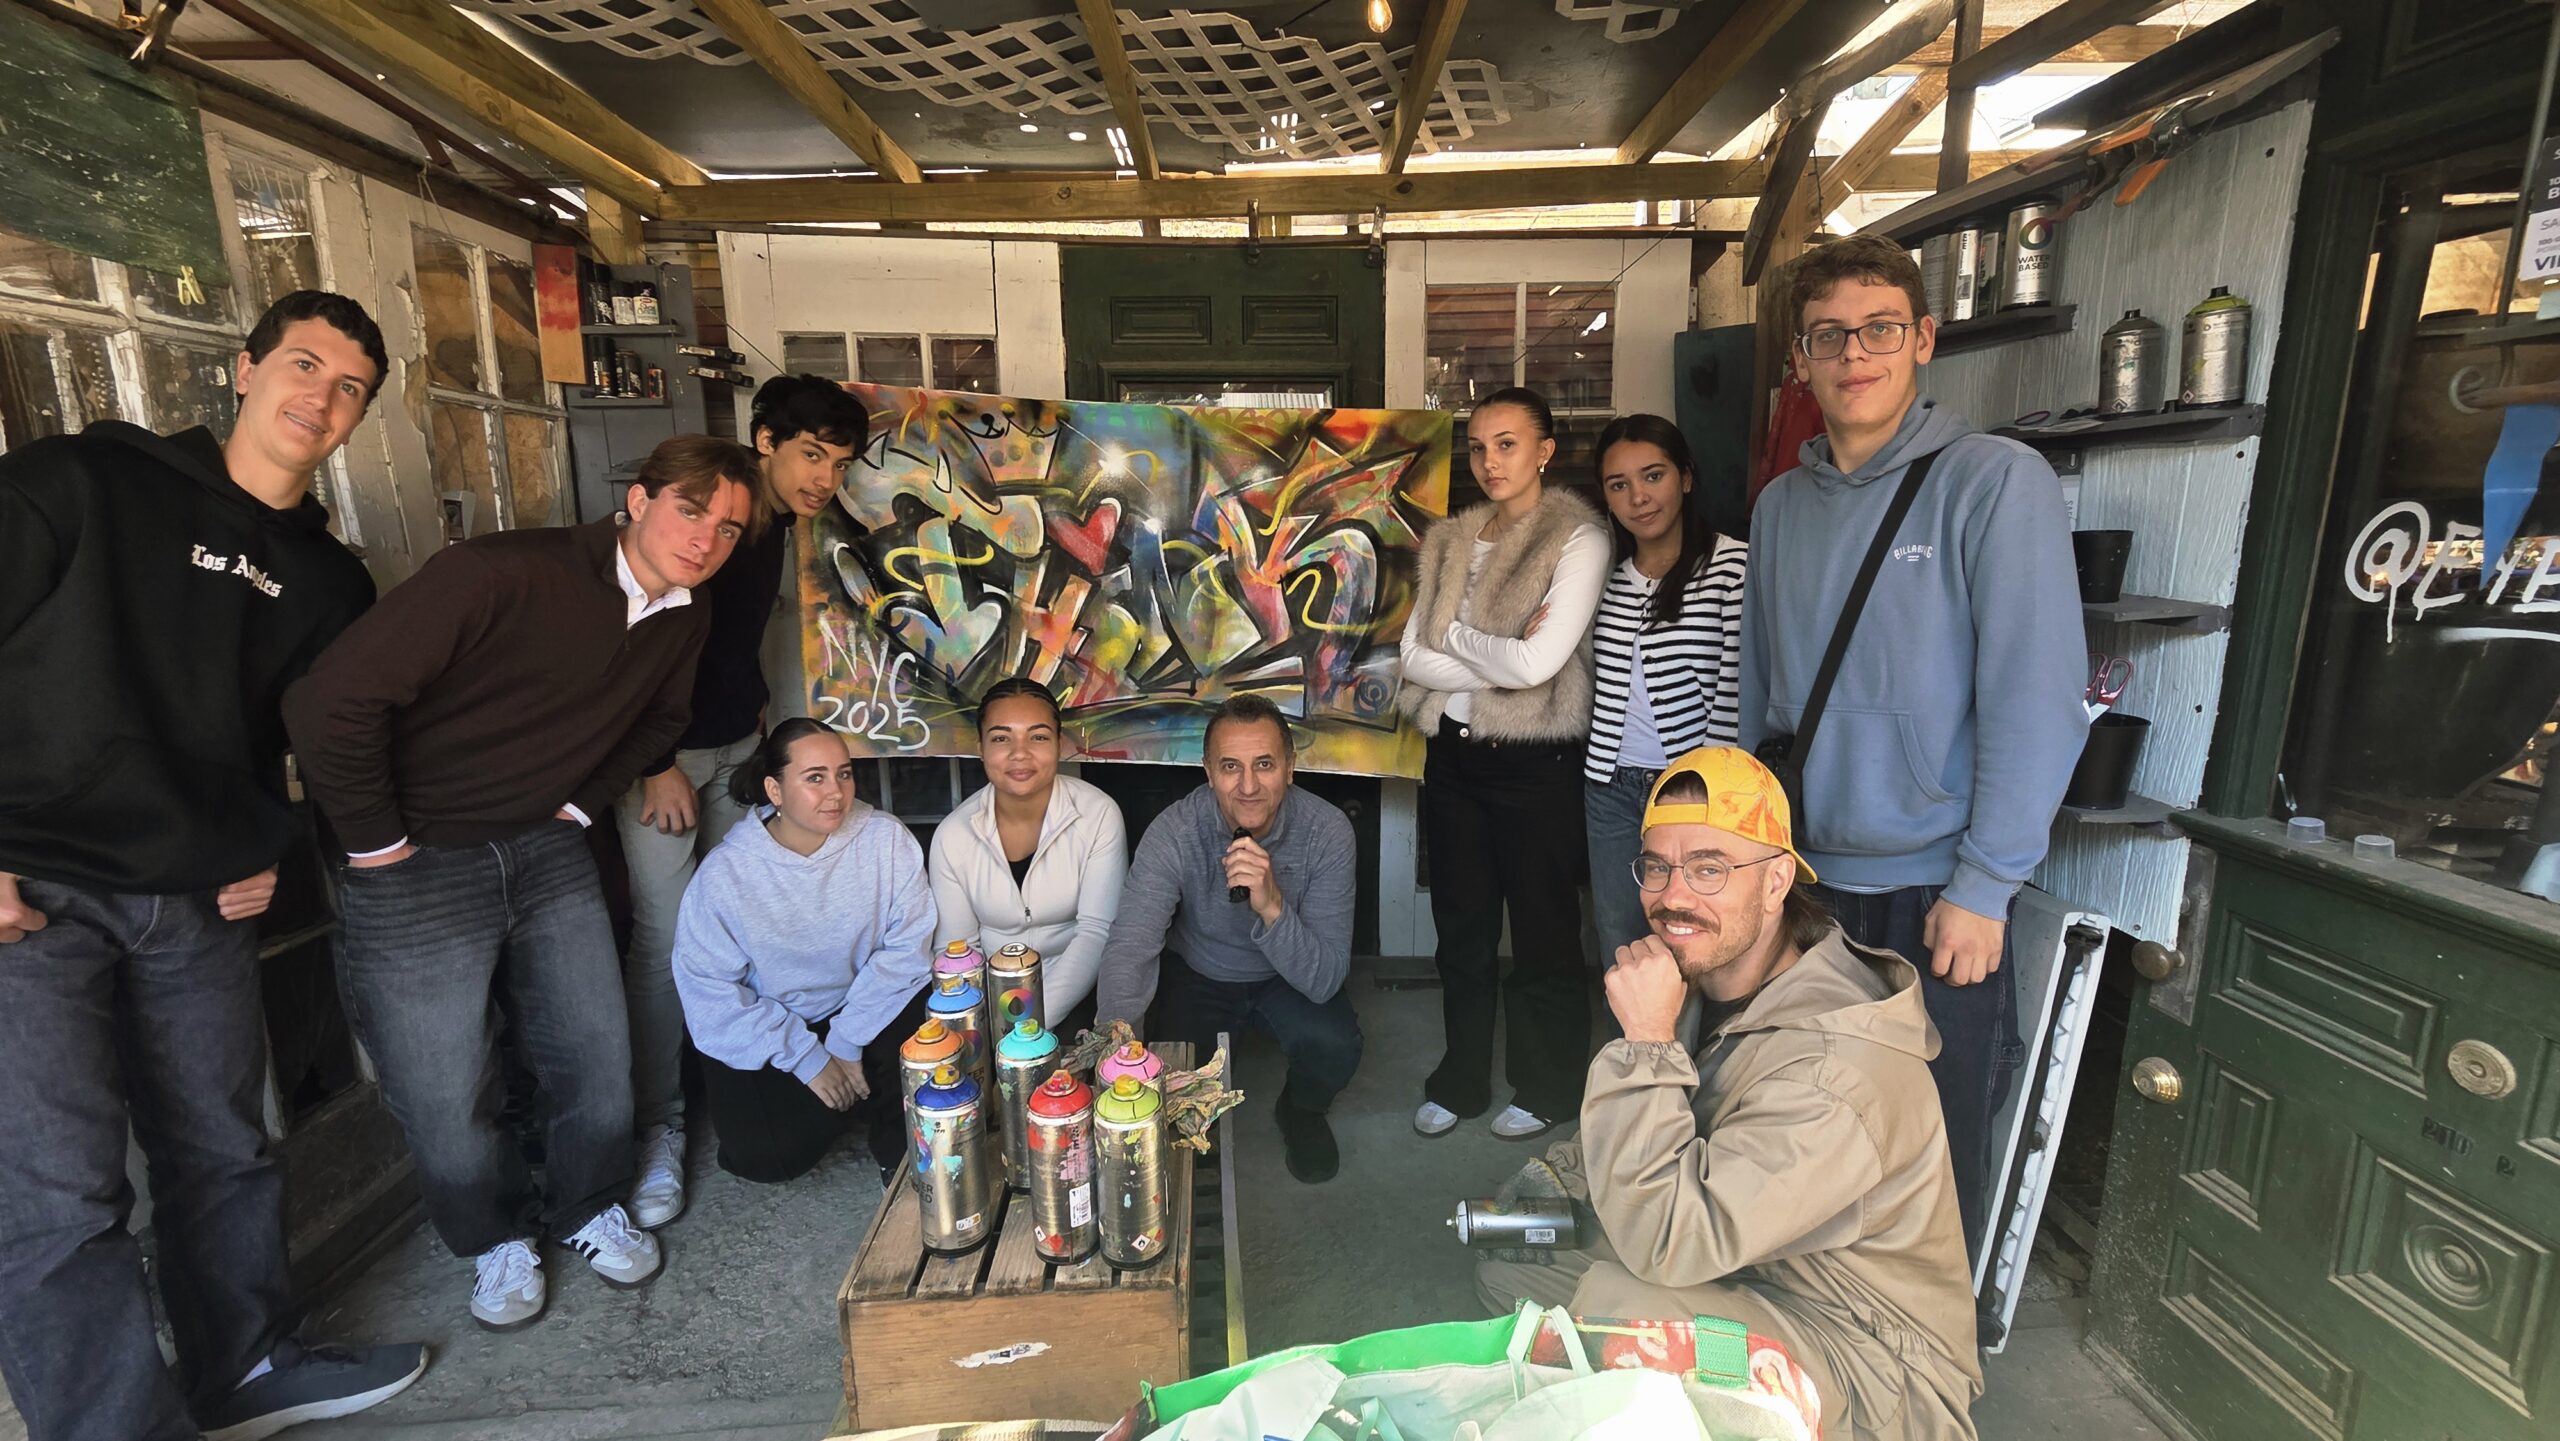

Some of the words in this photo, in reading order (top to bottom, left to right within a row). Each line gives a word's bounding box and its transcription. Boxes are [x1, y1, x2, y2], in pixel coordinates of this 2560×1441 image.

[2018, 254, 2050, 264] WATER
[2018, 262, 2049, 272] BASED
[191, 543, 228, 571] Los
[818, 612, 918, 712] NYC
[817, 695, 931, 751] 2025
